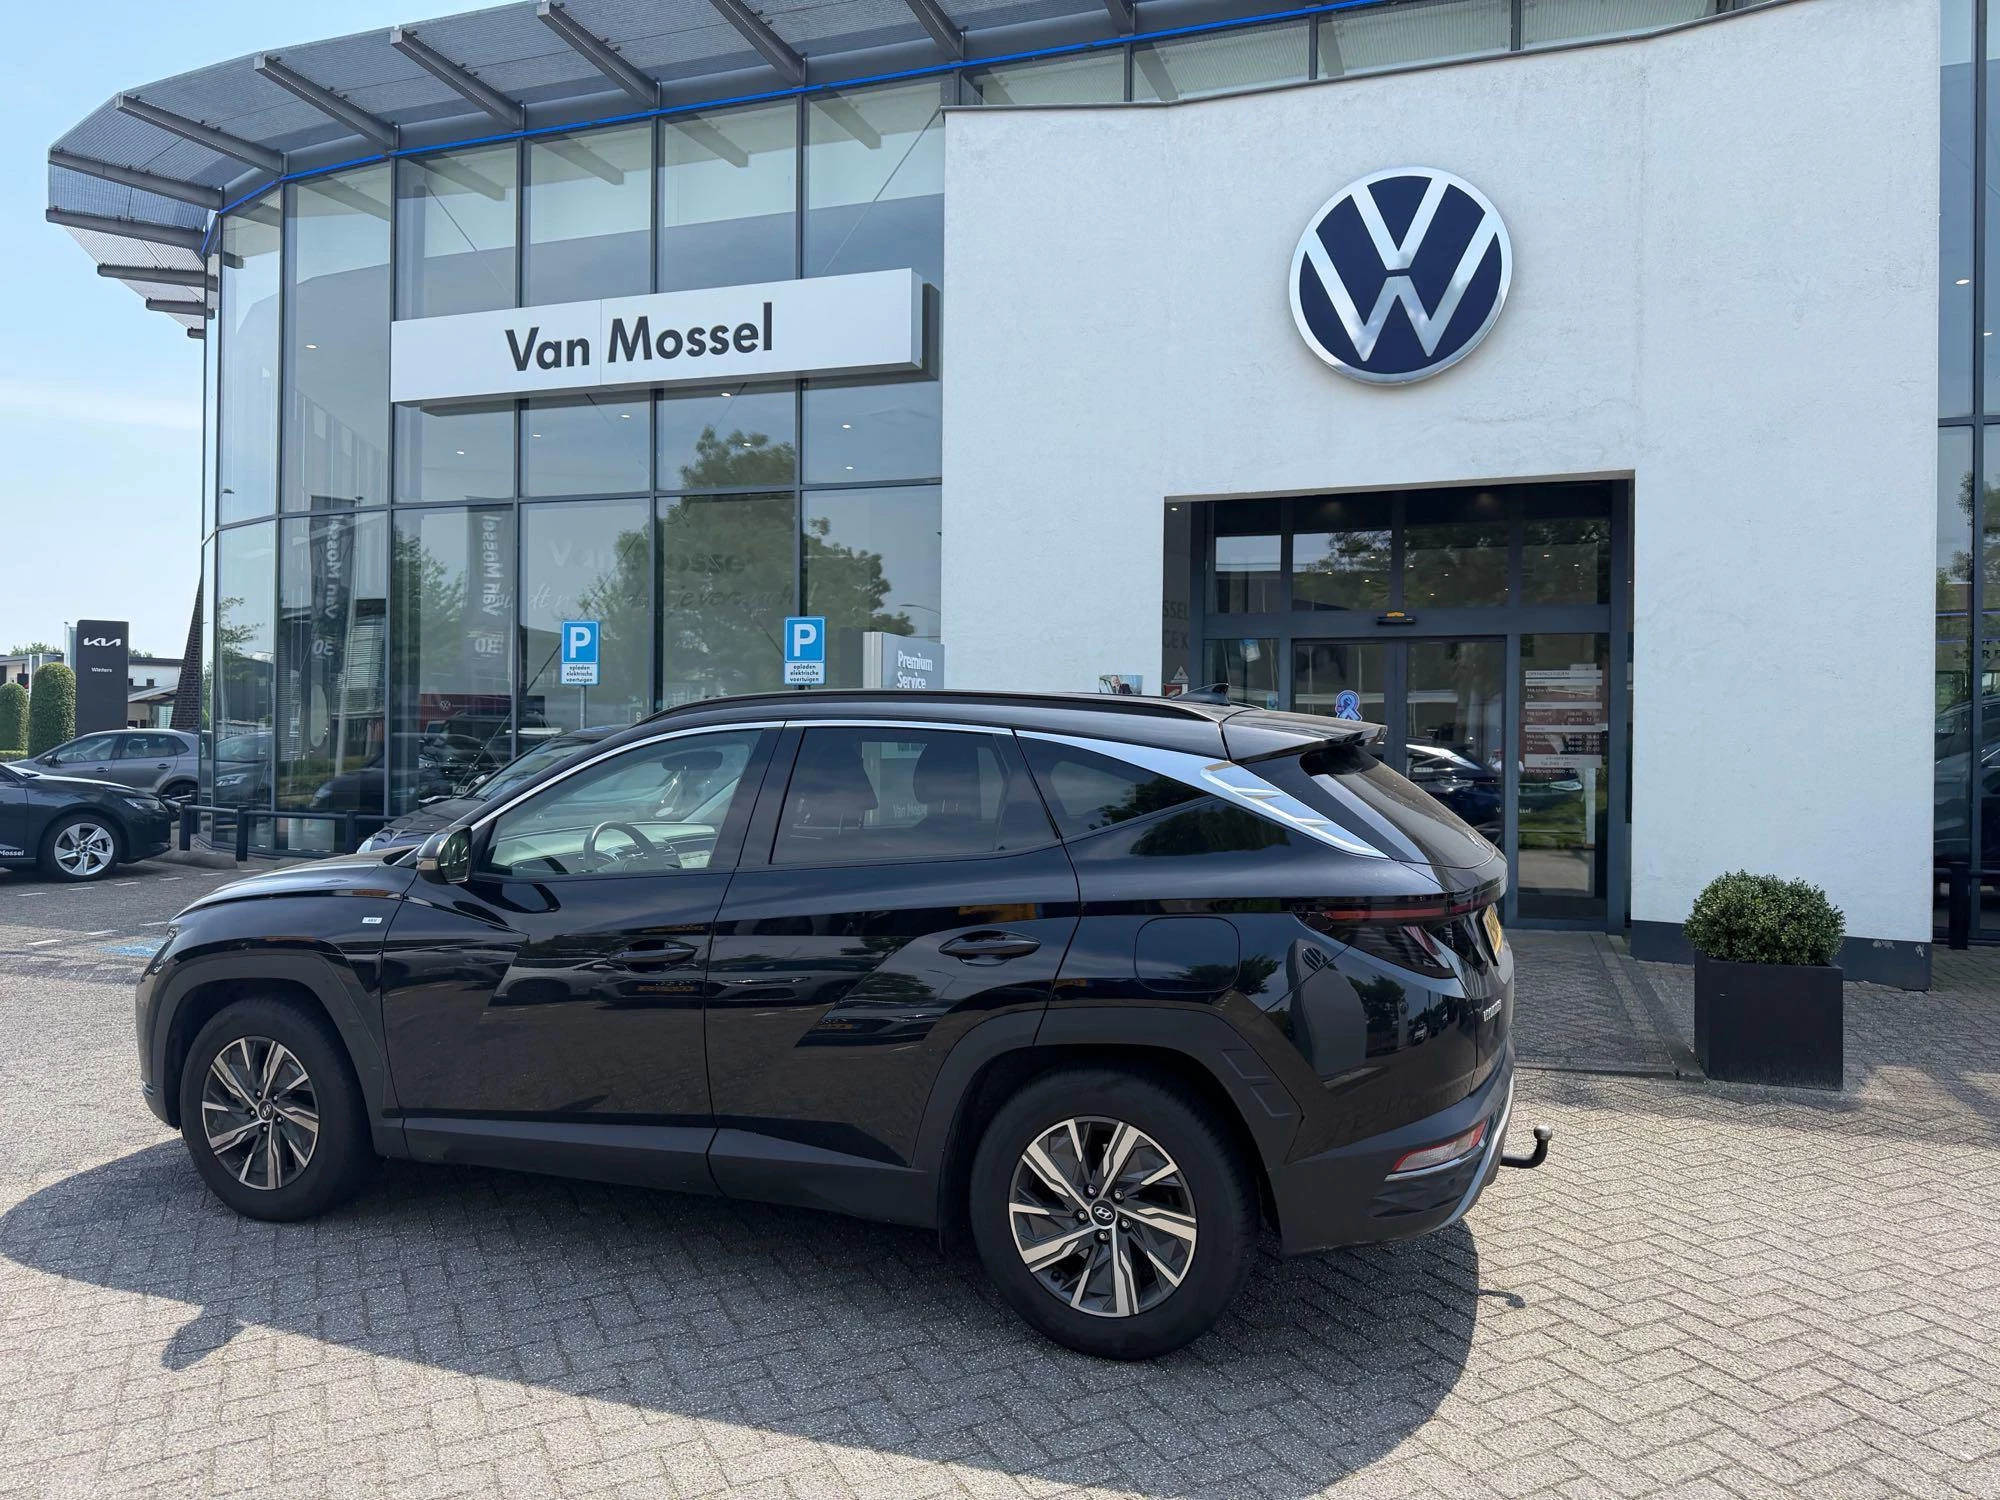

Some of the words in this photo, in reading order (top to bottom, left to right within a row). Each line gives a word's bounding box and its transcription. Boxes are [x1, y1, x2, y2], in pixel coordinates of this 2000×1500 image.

[1299, 175, 1498, 362] VW
[505, 327, 590, 371] Van
[608, 302, 772, 363] Mossel
[83, 637, 121, 647] KIA
[570, 627, 591, 659] P
[793, 623, 817, 657] P
[897, 650, 933, 672] Premium
[896, 671, 927, 688] Service
